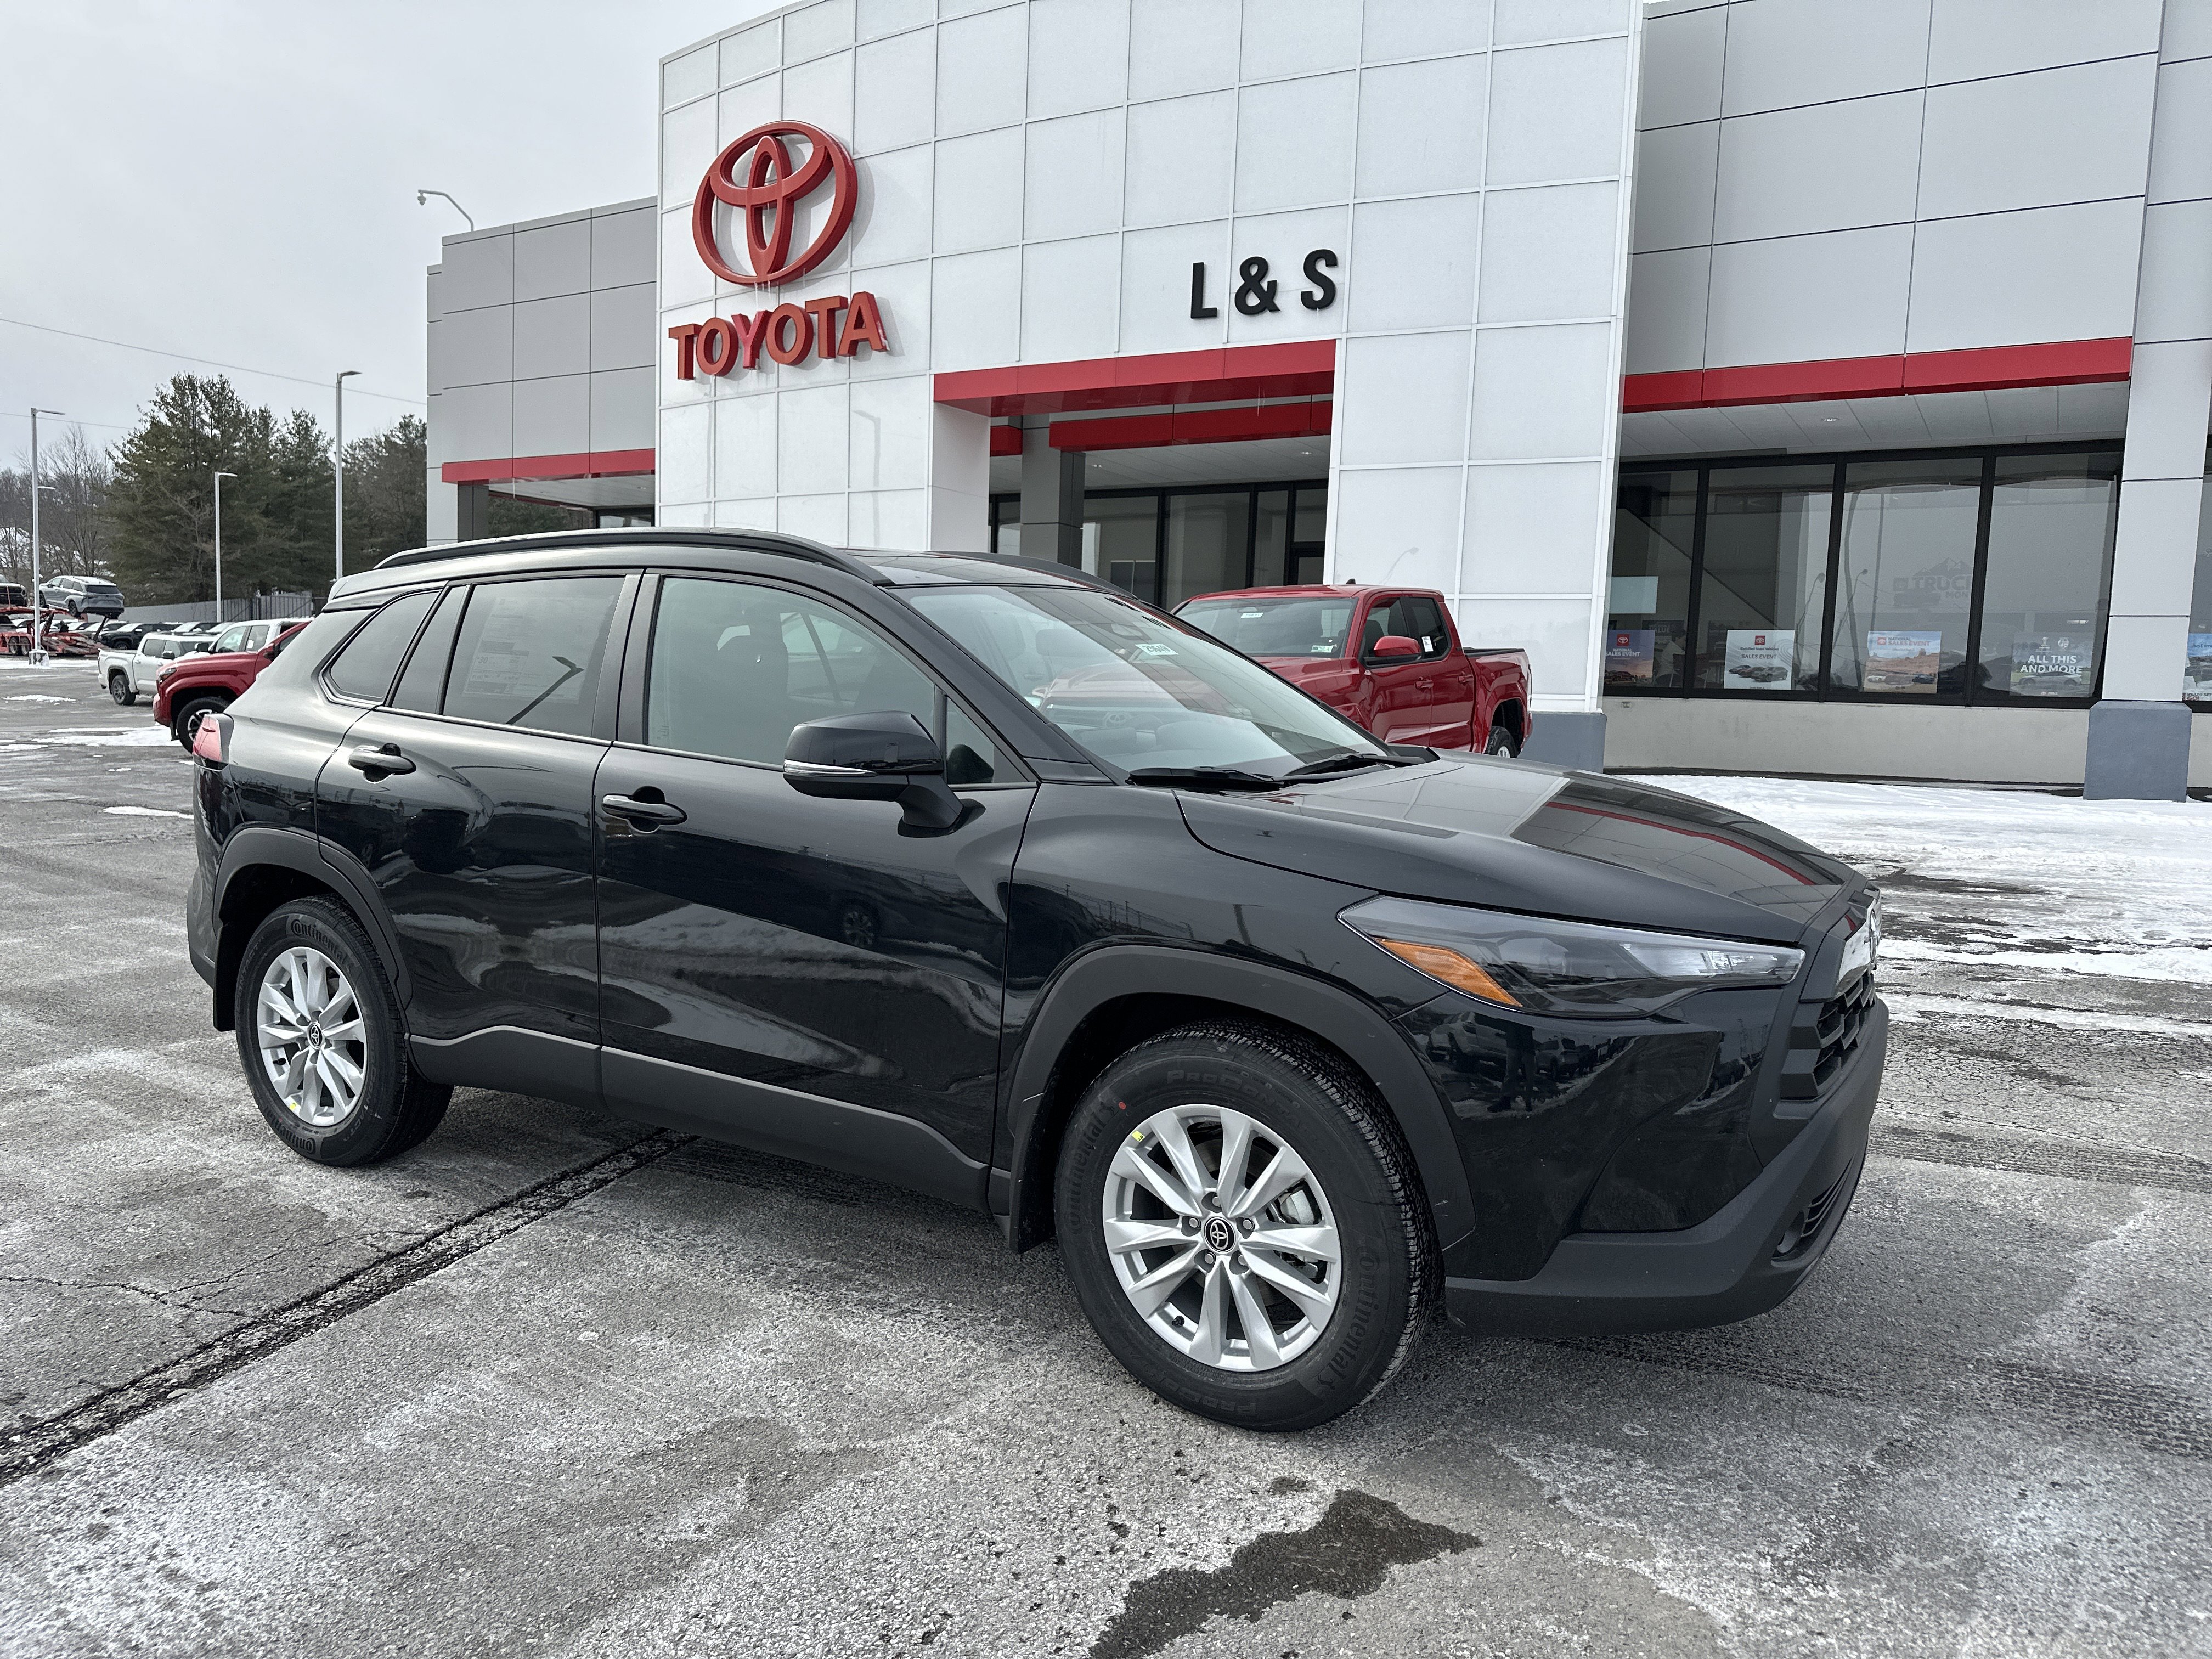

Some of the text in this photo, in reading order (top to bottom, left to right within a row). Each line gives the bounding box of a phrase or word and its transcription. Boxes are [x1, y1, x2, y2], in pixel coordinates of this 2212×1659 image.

[1190, 249, 1338, 319] L & S
[668, 291, 890, 381] TOYOTA
[2019, 664, 2083, 674] AND MORE
[2028, 655, 2077, 663] ALL THIS
[290, 919, 345, 964] Continental
[1328, 1246, 1380, 1380] Continental
